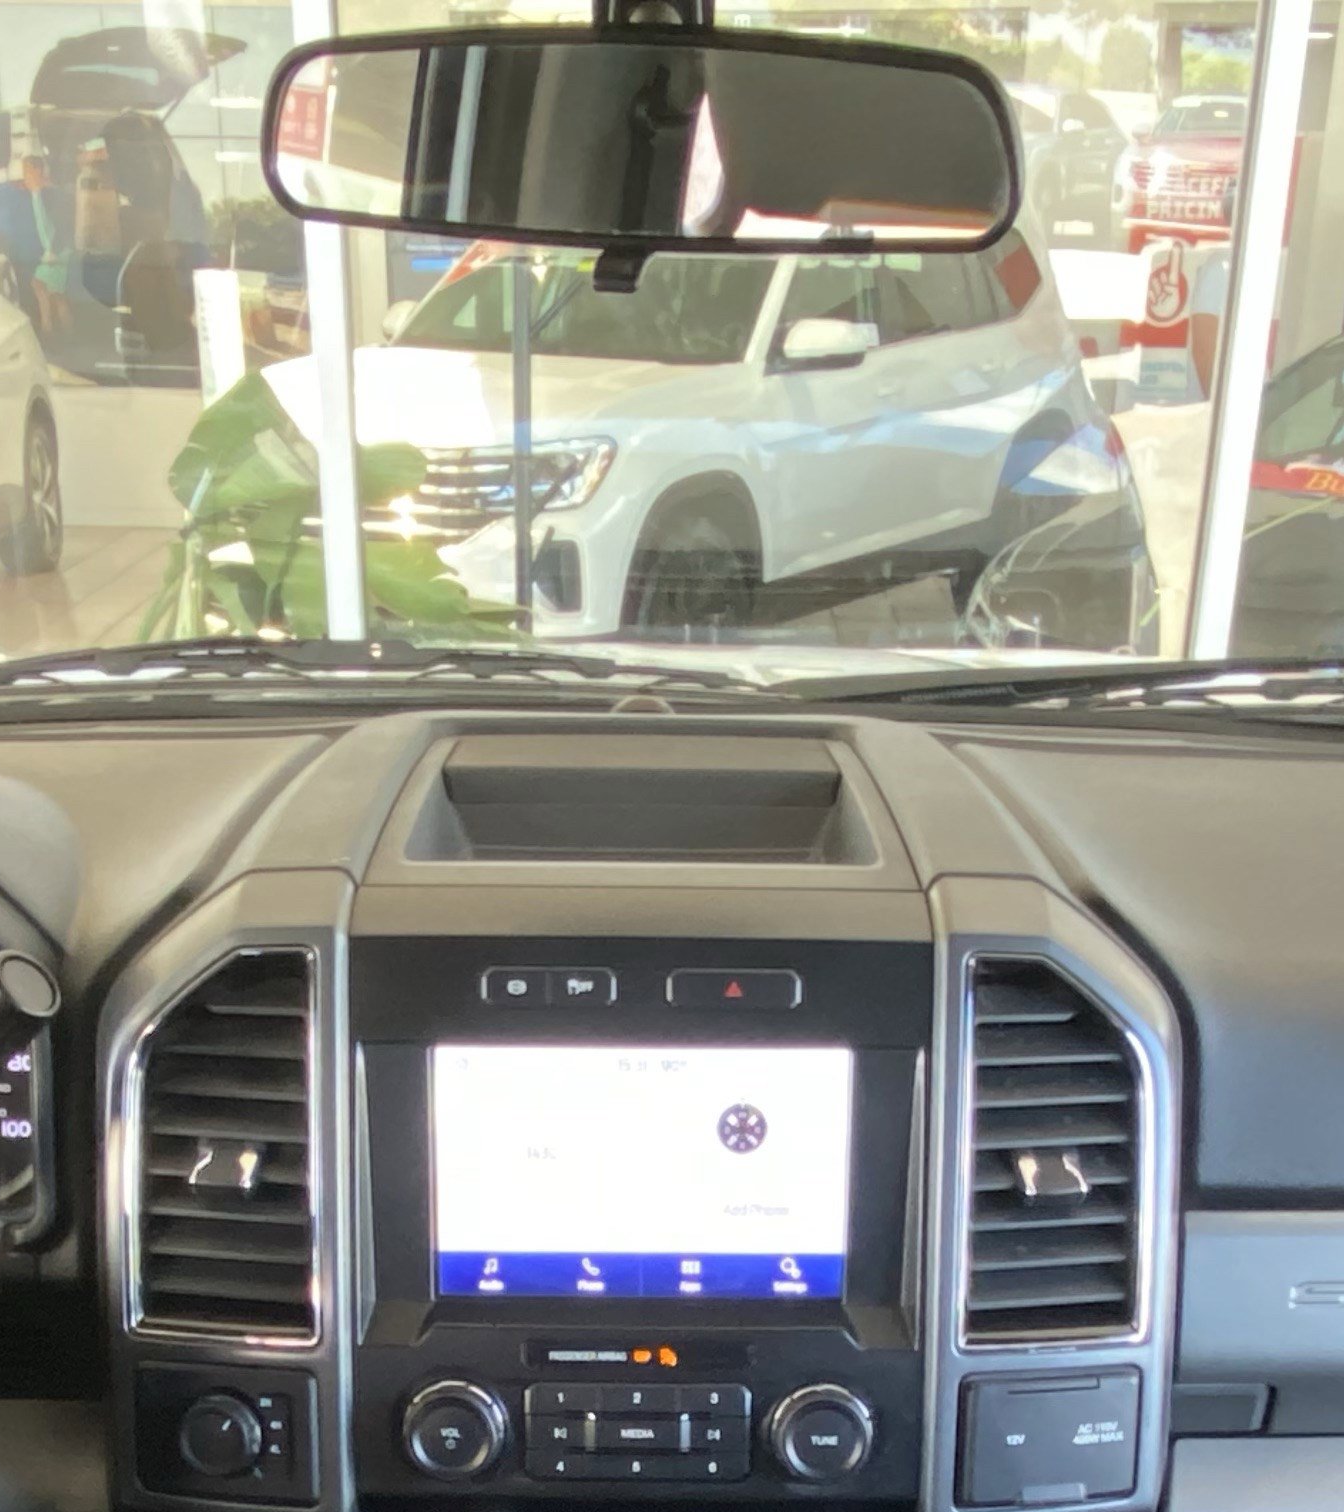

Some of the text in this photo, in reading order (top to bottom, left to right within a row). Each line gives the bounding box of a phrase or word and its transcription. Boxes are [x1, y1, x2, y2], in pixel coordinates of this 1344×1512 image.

[0, 1120, 33, 1139] 100
[557, 1391, 565, 1404] 1
[632, 1391, 642, 1404] 2
[709, 1391, 719, 1405] 3
[440, 1427, 461, 1438] VOL
[620, 1428, 655, 1439] MEDIA
[810, 1434, 839, 1446] TUNE
[555, 1460, 565, 1472] 4
